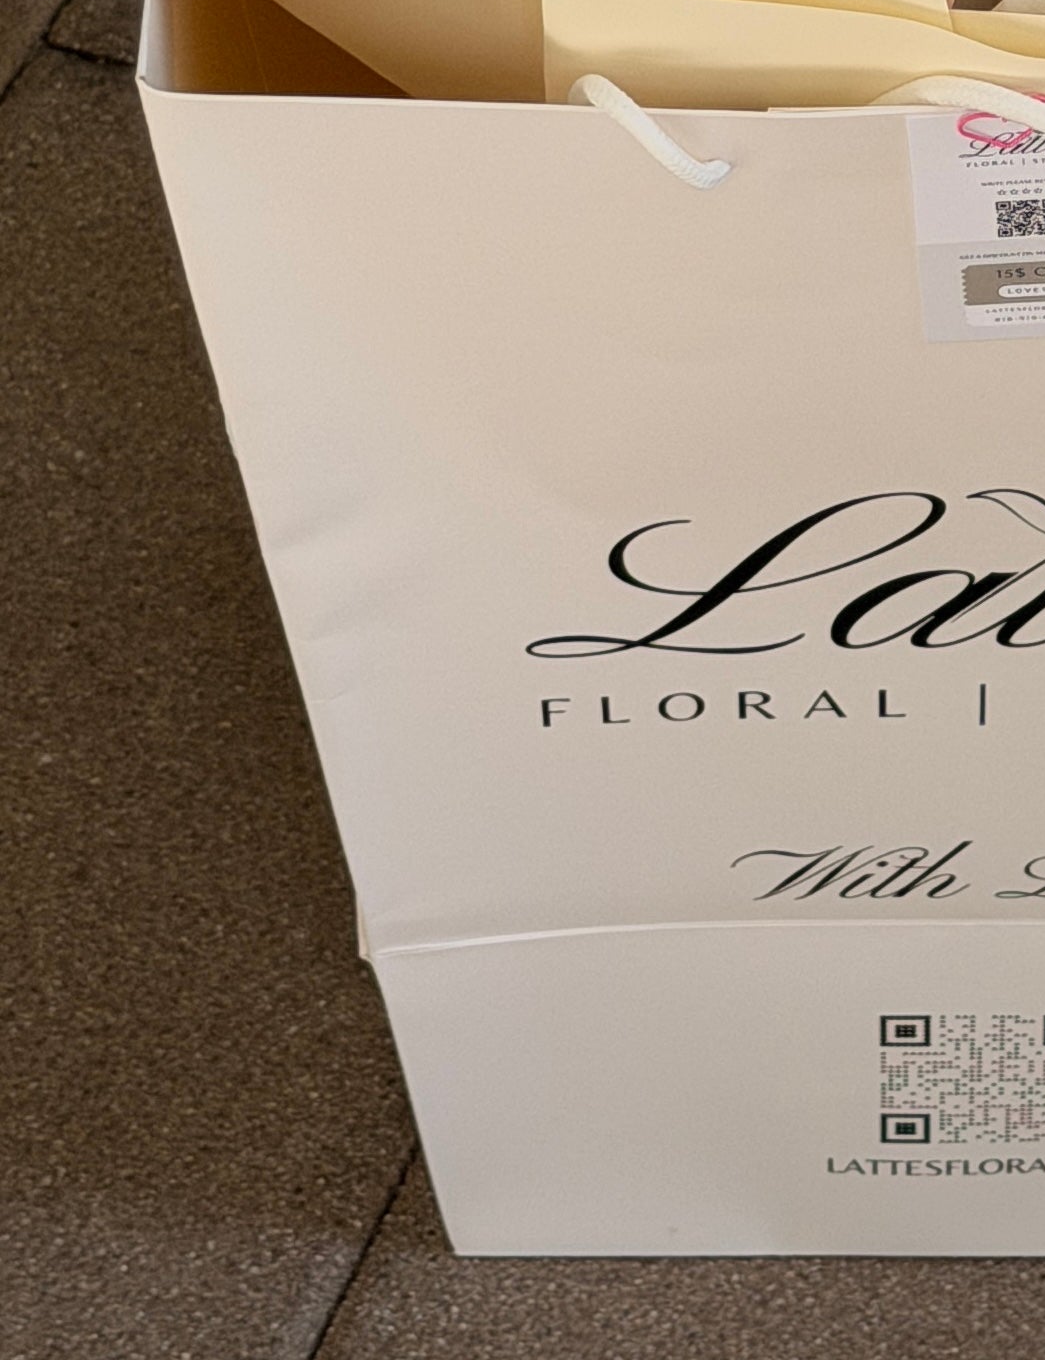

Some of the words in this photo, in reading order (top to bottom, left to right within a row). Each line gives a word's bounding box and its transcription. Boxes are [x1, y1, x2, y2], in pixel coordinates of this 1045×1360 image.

[966, 159, 1015, 168] FLORAL
[996, 268, 1026, 279] 15$
[541, 688, 908, 727] FLORAL
[730, 840, 974, 902] With
